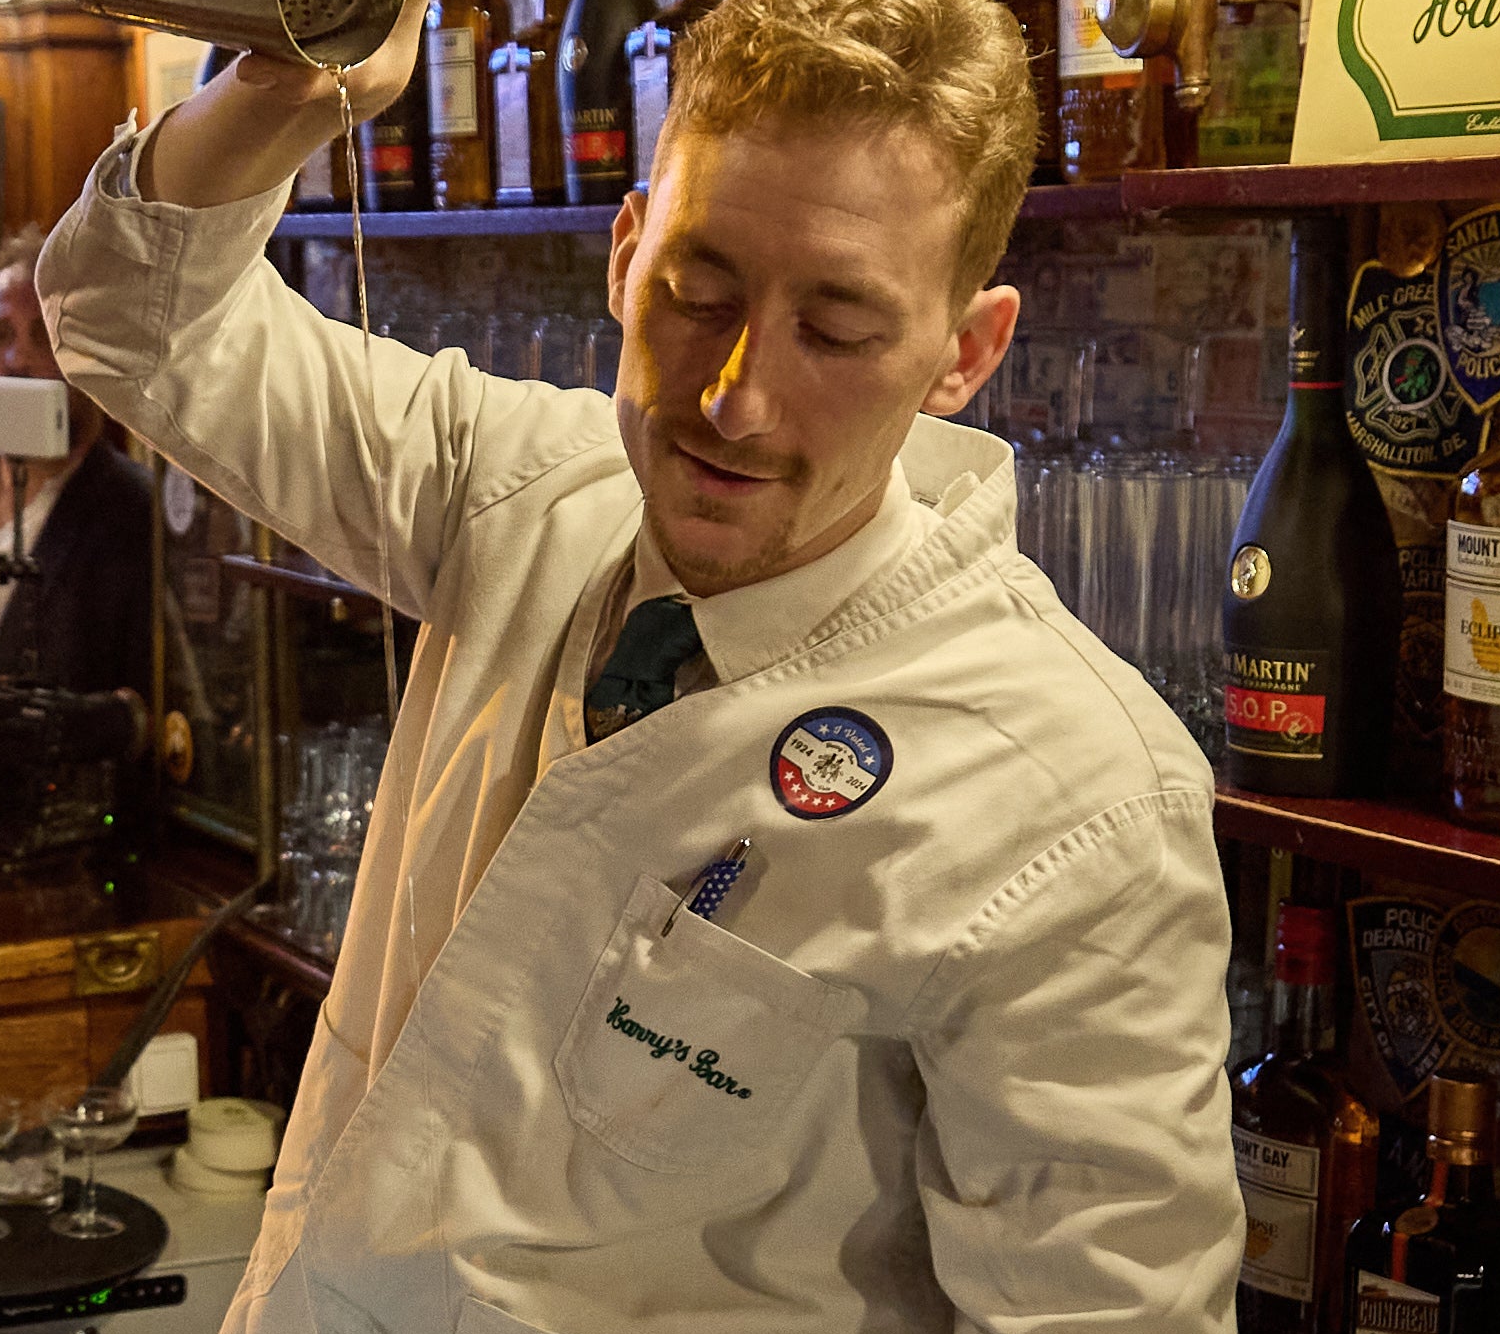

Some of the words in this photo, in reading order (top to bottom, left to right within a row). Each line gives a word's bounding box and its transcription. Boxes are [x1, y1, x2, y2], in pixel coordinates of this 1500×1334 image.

[1446, 215, 1500, 257] SANTA
[1233, 651, 1312, 684] MARTIN
[789, 737, 815, 758] 1924
[843, 727, 872, 755] Voted
[844, 775, 869, 792] 2024
[606, 996, 692, 1063] Harry's
[688, 1049, 741, 1101] Bar
[1261, 1145, 1289, 1168] GAY
